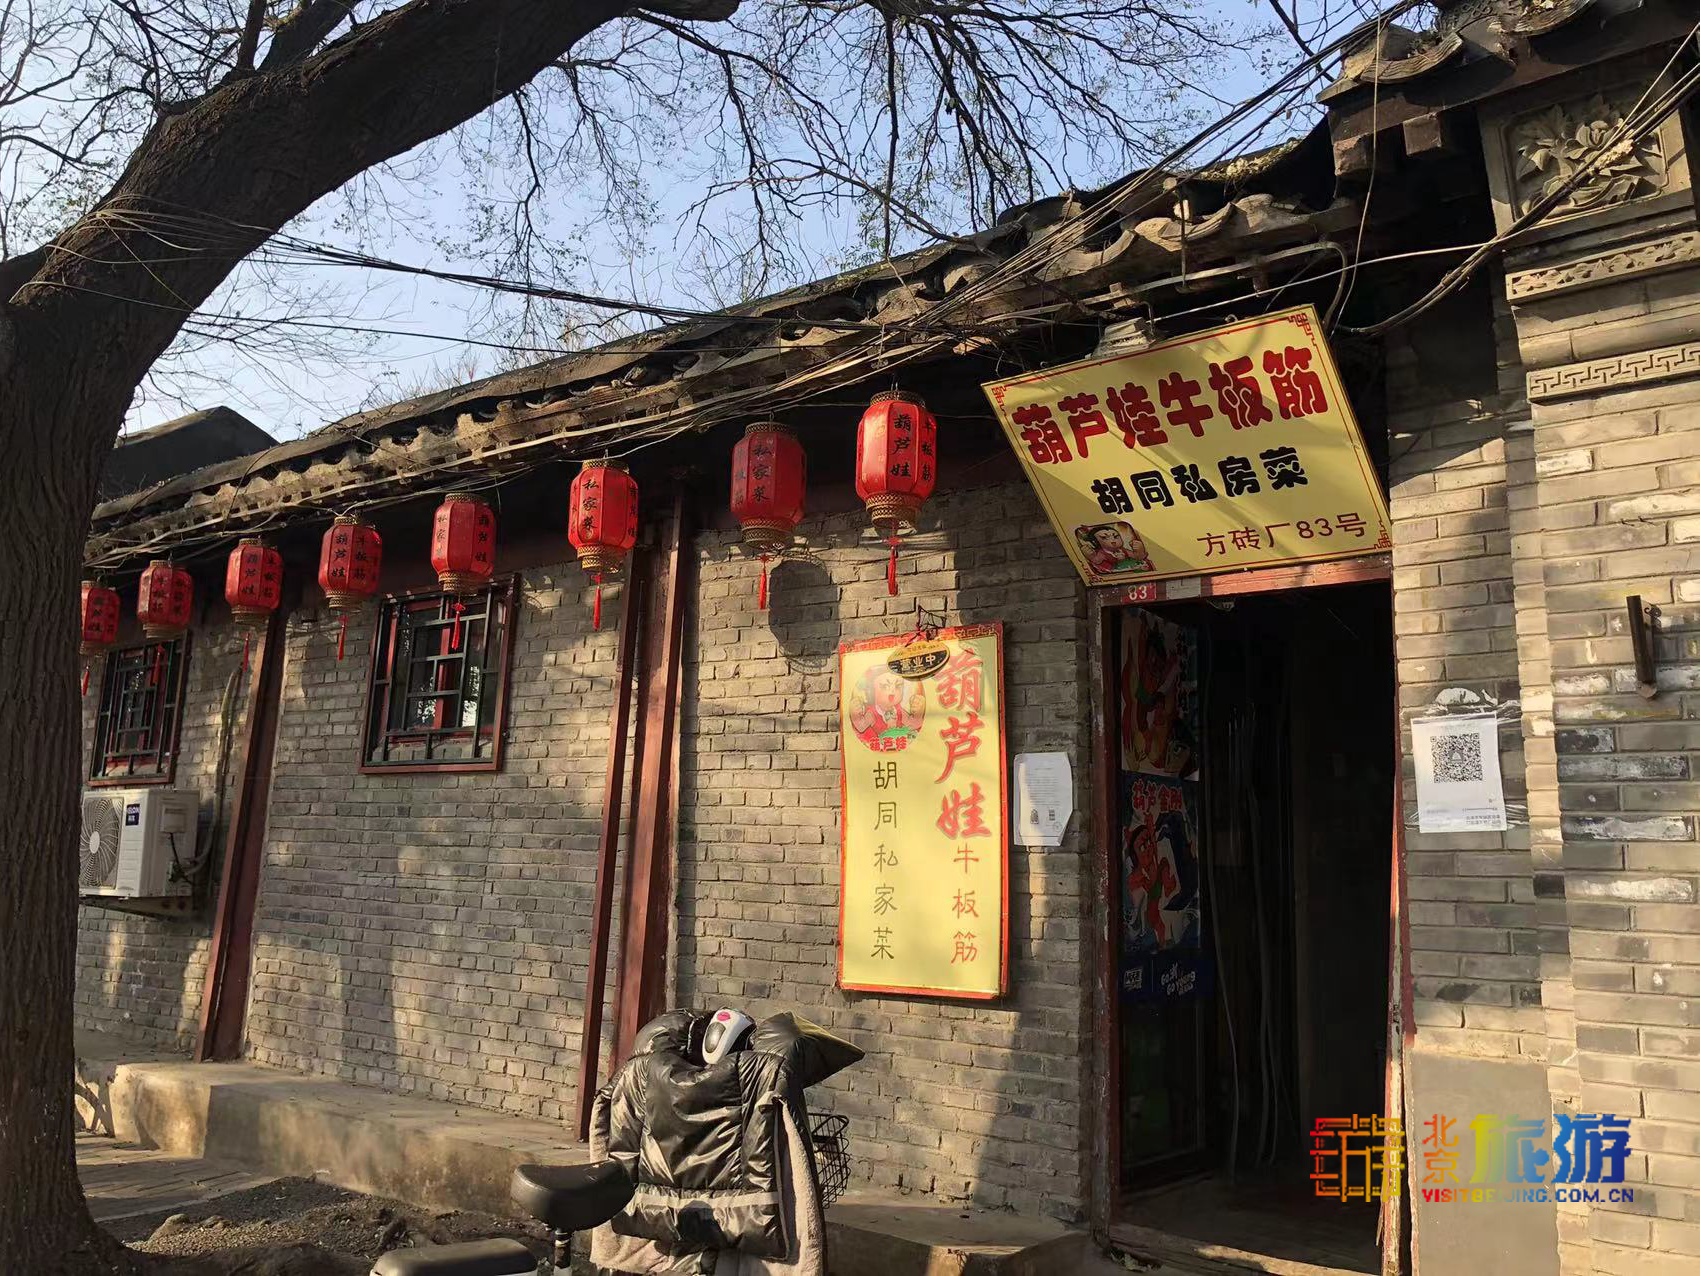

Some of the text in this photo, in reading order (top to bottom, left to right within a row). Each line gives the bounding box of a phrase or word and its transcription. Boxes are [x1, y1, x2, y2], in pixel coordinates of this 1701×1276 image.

[1012, 346, 1329, 465] 葫芦娃牛板筋
[752, 444, 772, 502] 私家菜
[889, 412, 912, 478] 葫芦娃
[581, 477, 600, 531] 私家菜
[1090, 446, 1308, 516] 胡同私房菜
[331, 532, 349, 578] 葫芦娃
[1197, 511, 1368, 558] 方砖厂83号
[1128, 584, 1149, 601] 83
[901, 653, 936, 674] 营业中
[869, 736, 908, 752] 葫芦娃
[934, 649, 991, 841] 葫芦娃
[870, 760, 899, 961] 胡同私家菜
[951, 843, 980, 966] 牛板筋
